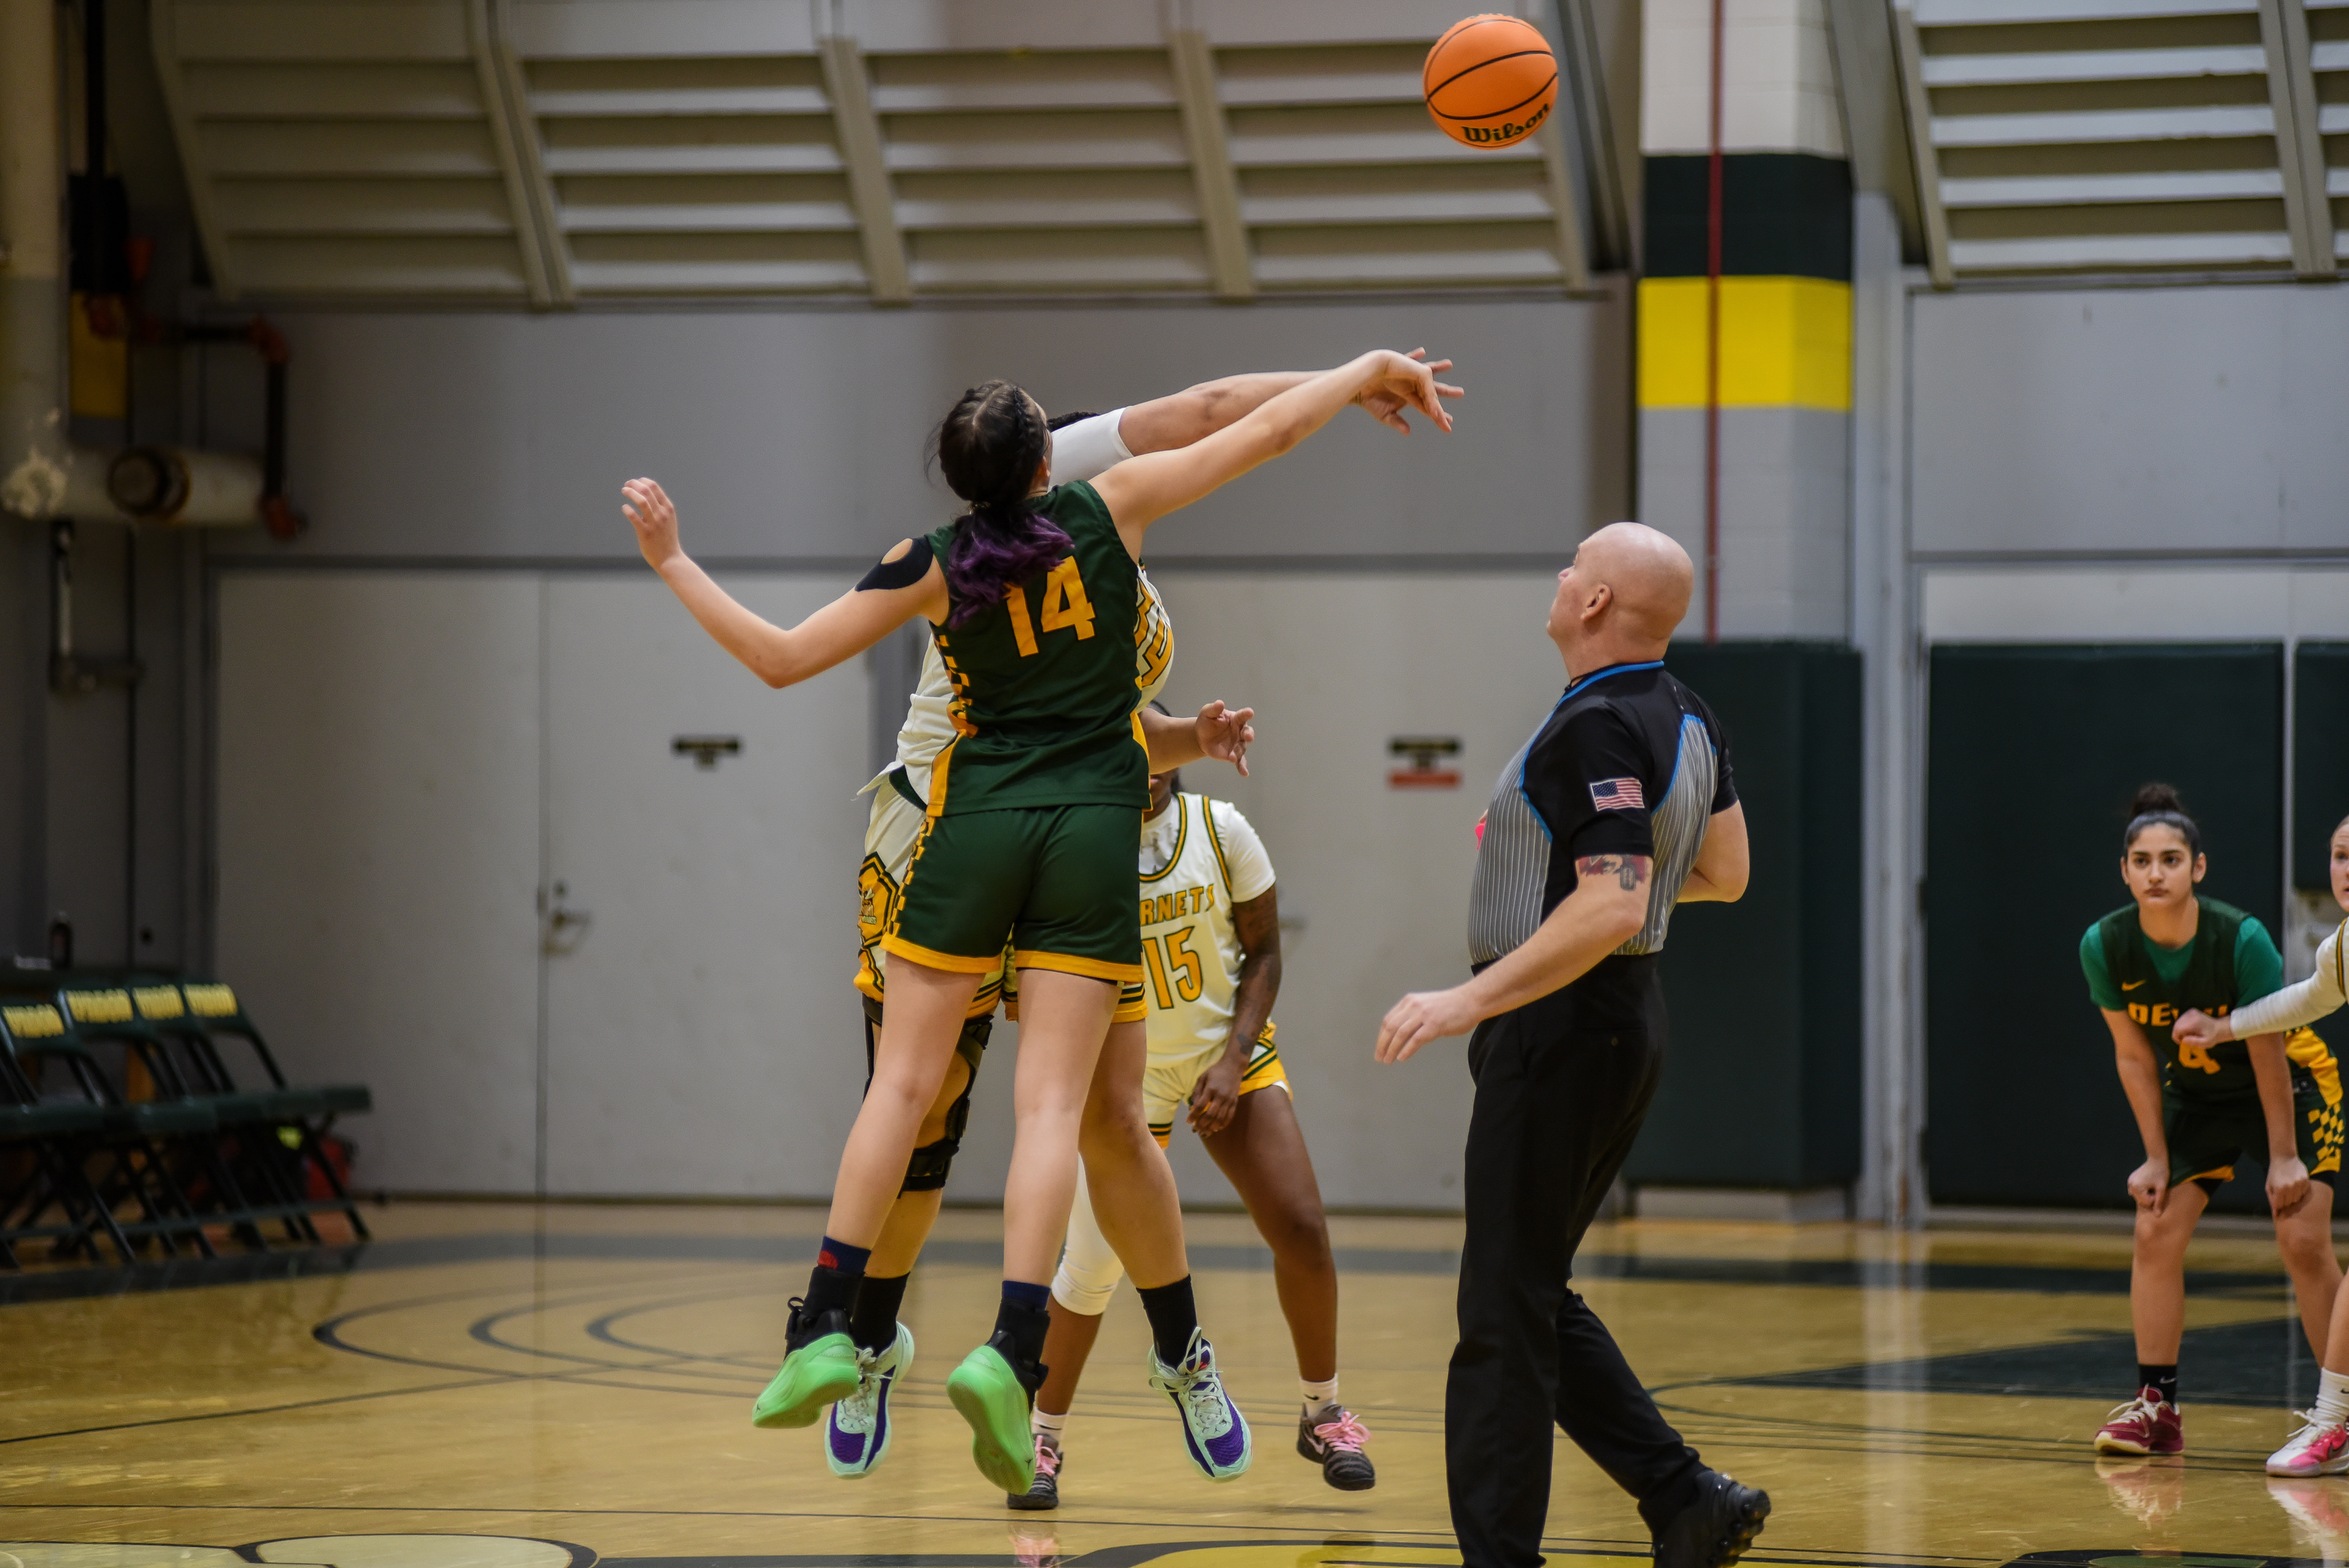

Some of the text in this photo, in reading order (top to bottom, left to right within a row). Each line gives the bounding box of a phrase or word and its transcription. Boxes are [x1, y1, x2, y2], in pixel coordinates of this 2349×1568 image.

[1461, 103, 1549, 143] Wilson
[1003, 555, 1096, 658] 14
[1140, 883, 1215, 927] RNETS
[1141, 926, 1204, 1010] 15
